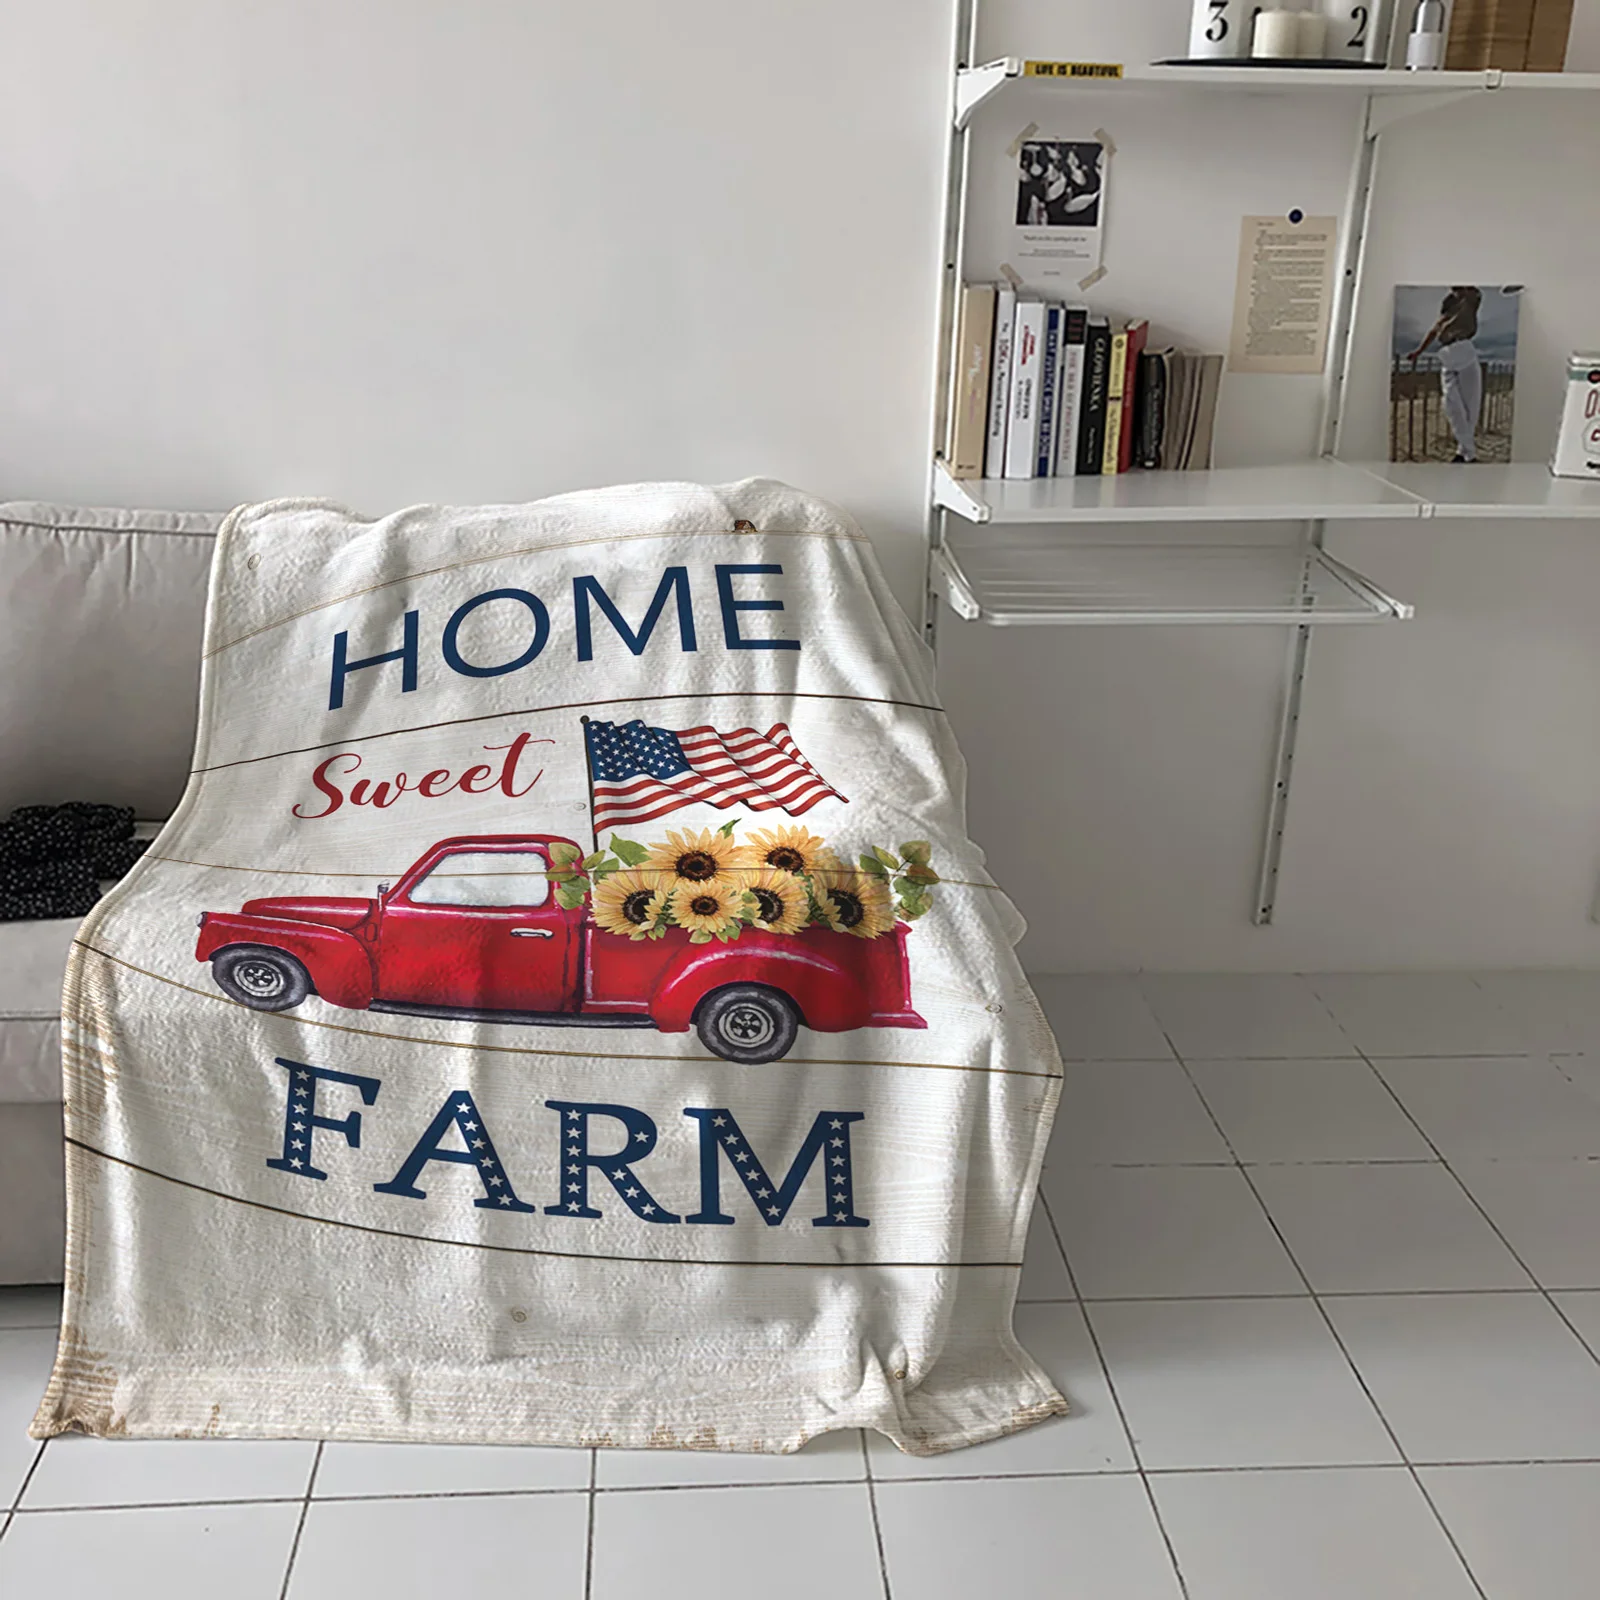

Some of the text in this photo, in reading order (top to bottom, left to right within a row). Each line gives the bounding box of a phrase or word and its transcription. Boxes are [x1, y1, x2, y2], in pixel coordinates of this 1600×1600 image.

[1205, 0, 1228, 42] 3
[1347, 6, 1368, 47] 2
[1035, 64, 1119, 77] LIFE IS BEAUTIFUL
[329, 564, 801, 709] HOME
[293, 732, 556, 819] Sweet
[266, 1057, 870, 1228] FARM
